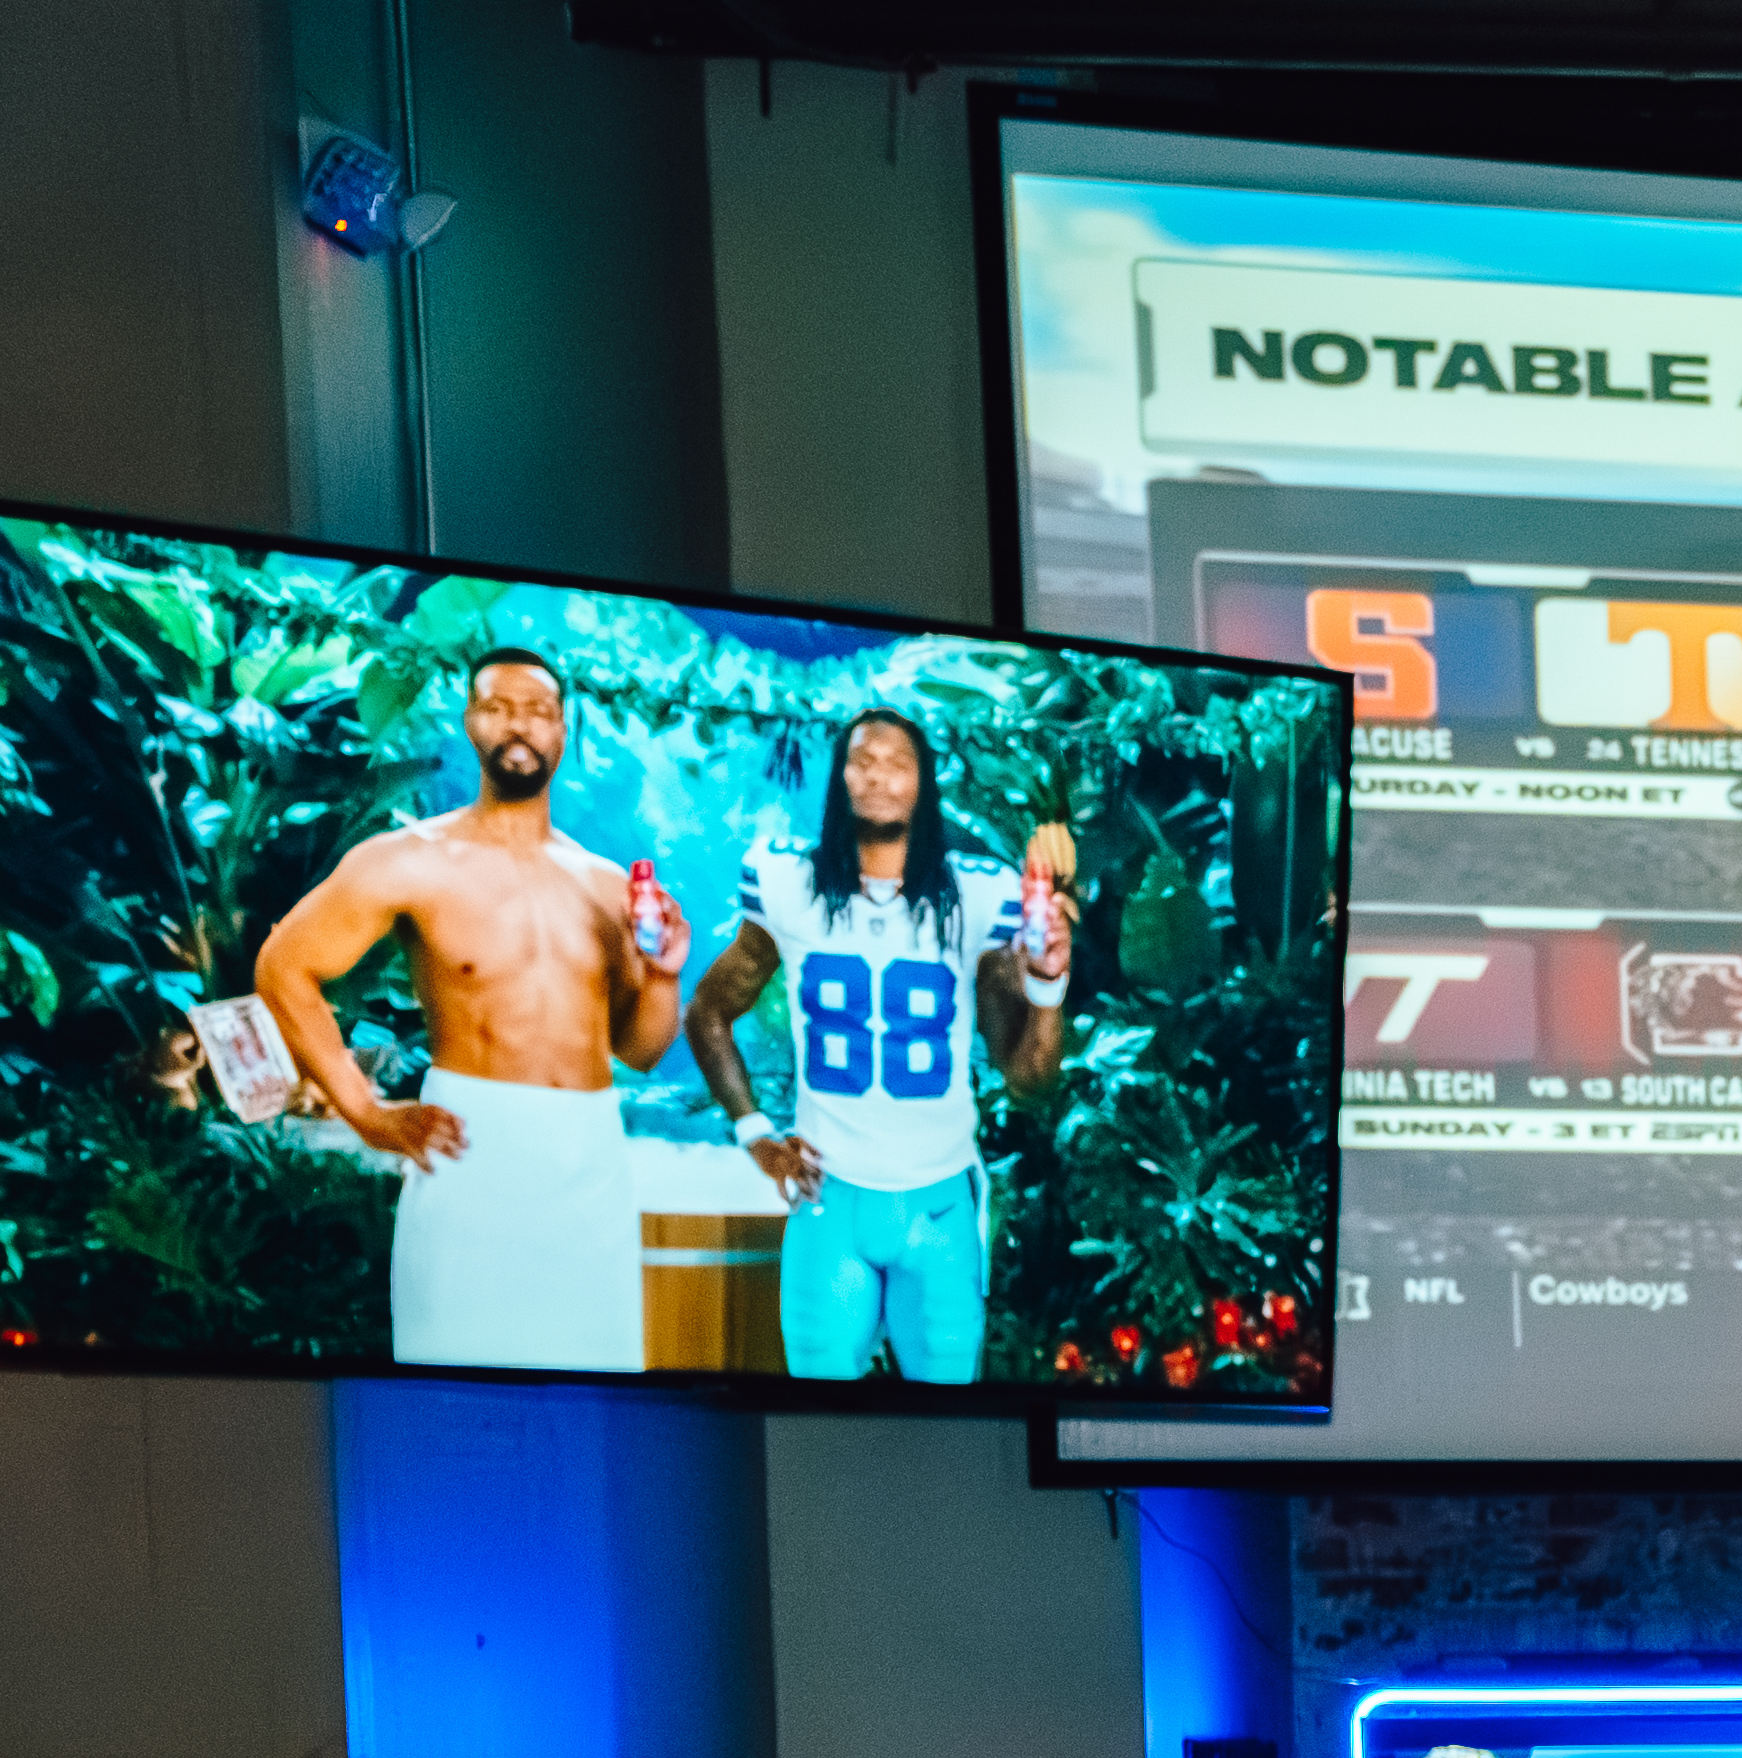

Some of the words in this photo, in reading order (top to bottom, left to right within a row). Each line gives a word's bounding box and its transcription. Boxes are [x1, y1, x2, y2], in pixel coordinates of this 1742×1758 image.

[1211, 326, 1712, 406] NOTABLE
[1352, 727, 1453, 761] ACUSE
[1352, 776, 1483, 799] URDAY
[1518, 782, 1629, 804] NOON
[1641, 786, 1687, 805] ET
[800, 951, 958, 1100] 88
[1343, 1071, 1408, 1101] INIA
[1413, 1071, 1496, 1103] TECH
[1621, 1075, 1707, 1105] SOUTH
[1352, 1119, 1514, 1140] SUNDAY
[1591, 1123, 1636, 1141] ET
[1403, 1277, 1465, 1303] NFL
[1529, 1273, 1689, 1310] Cowboys
